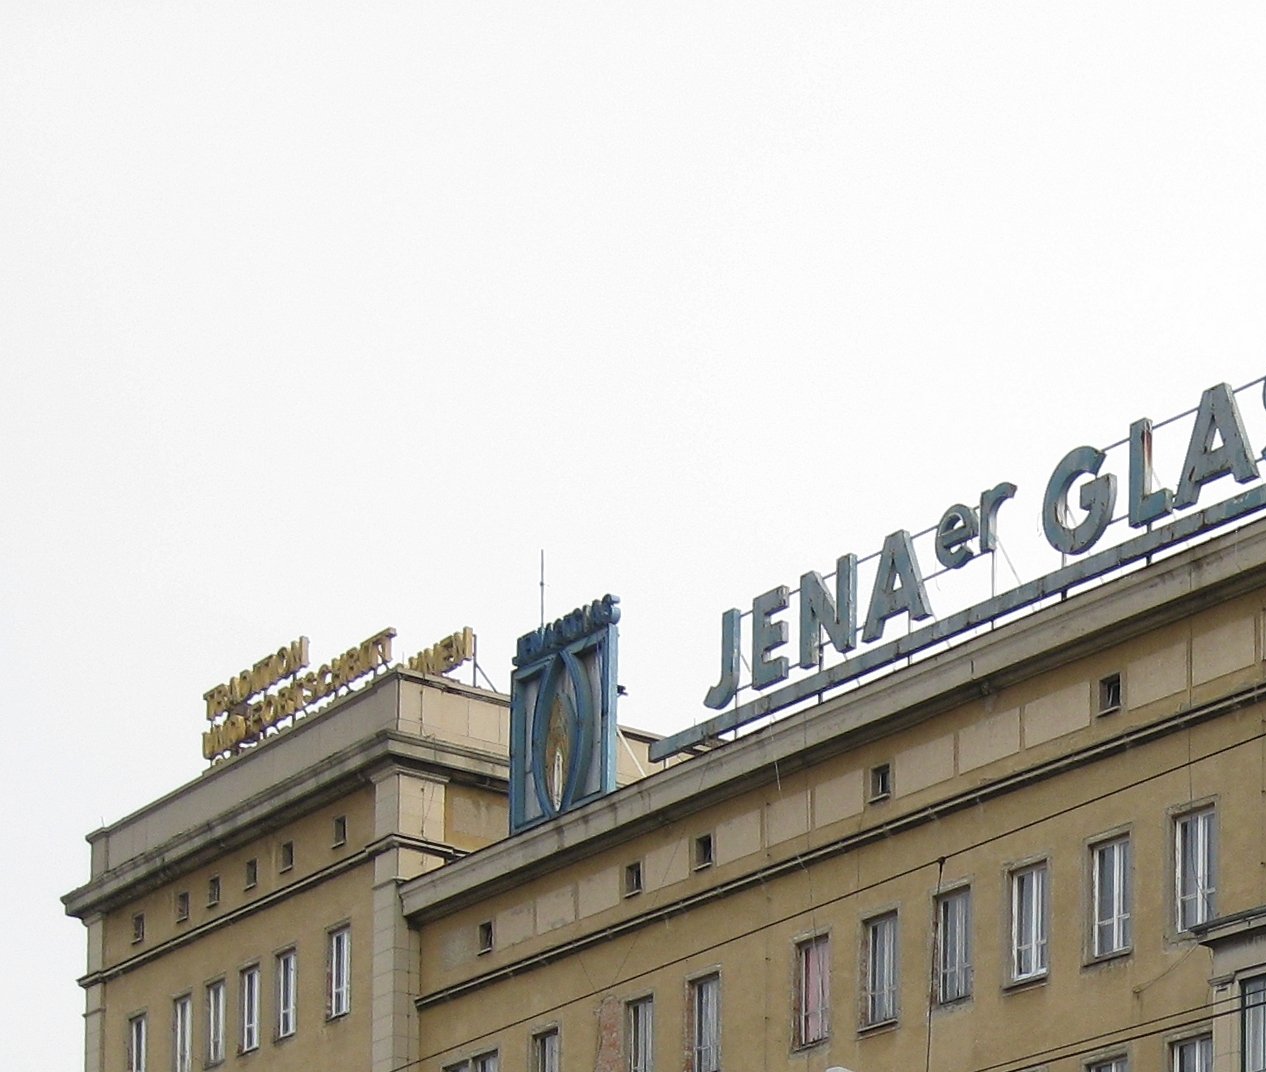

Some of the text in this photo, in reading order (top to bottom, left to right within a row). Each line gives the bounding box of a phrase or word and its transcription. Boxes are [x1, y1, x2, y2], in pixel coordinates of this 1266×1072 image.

[202, 714, 246, 760] UND
[248, 626, 397, 738] FORTSCHRITT
[203, 635, 310, 721] TRADITION
